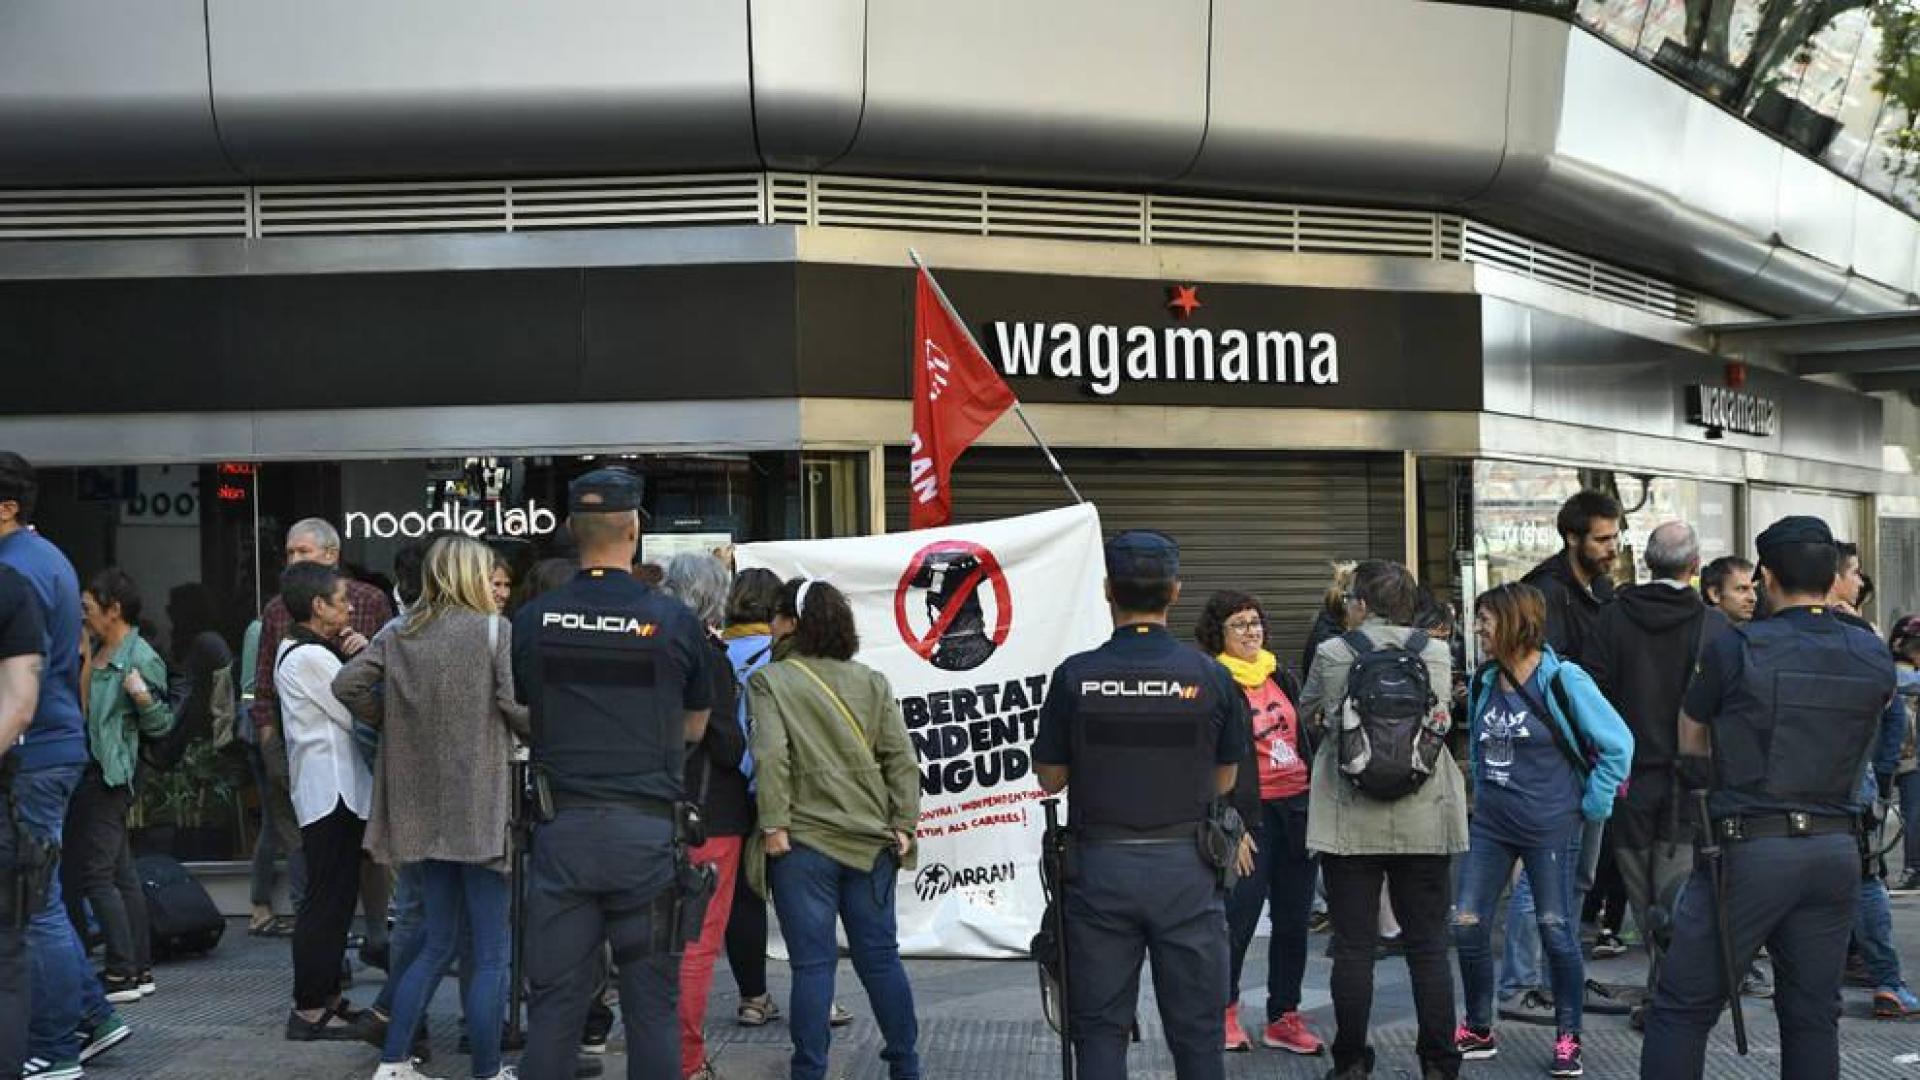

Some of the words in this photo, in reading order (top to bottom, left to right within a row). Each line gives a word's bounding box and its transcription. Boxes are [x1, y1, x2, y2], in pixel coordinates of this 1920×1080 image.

[994, 321, 1339, 395] wagamama
[345, 500, 487, 538] noodle
[495, 499, 556, 536] lab
[542, 612, 641, 637] POLICIA
[896, 674, 1046, 729] BERTAT
[1081, 680, 1184, 699] POLICIA
[952, 861, 1015, 888] ARRAN
